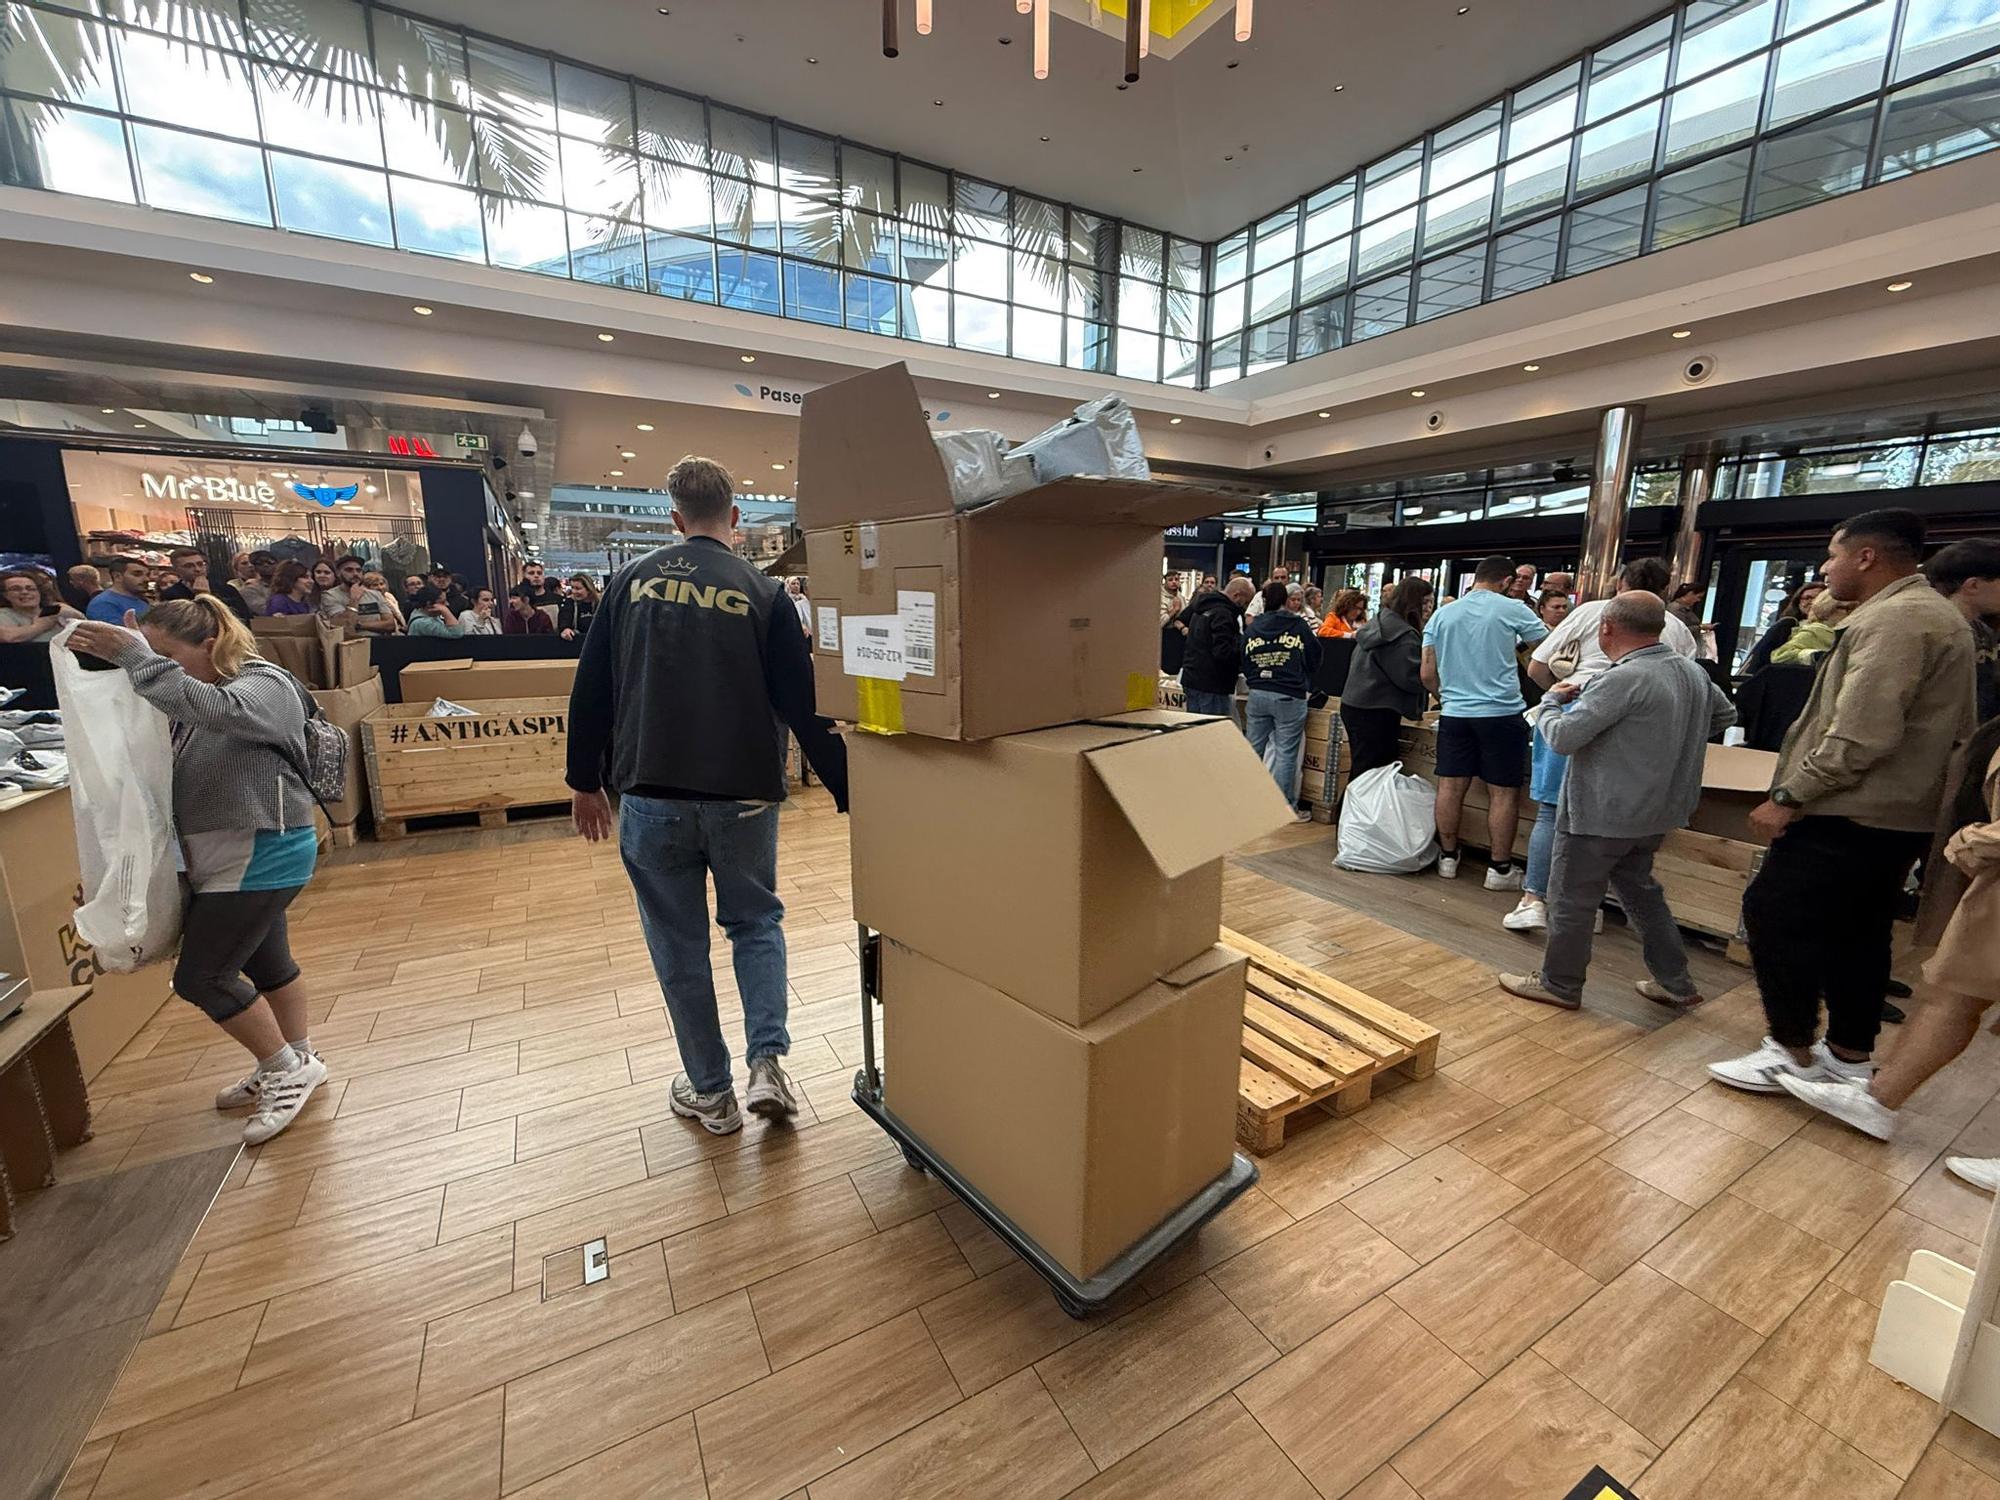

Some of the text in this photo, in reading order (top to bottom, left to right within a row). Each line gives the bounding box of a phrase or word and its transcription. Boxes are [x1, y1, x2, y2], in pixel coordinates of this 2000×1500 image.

[203, 477, 276, 503] Blue
[1183, 523, 1199, 537] hut
[630, 577, 750, 616] KING
